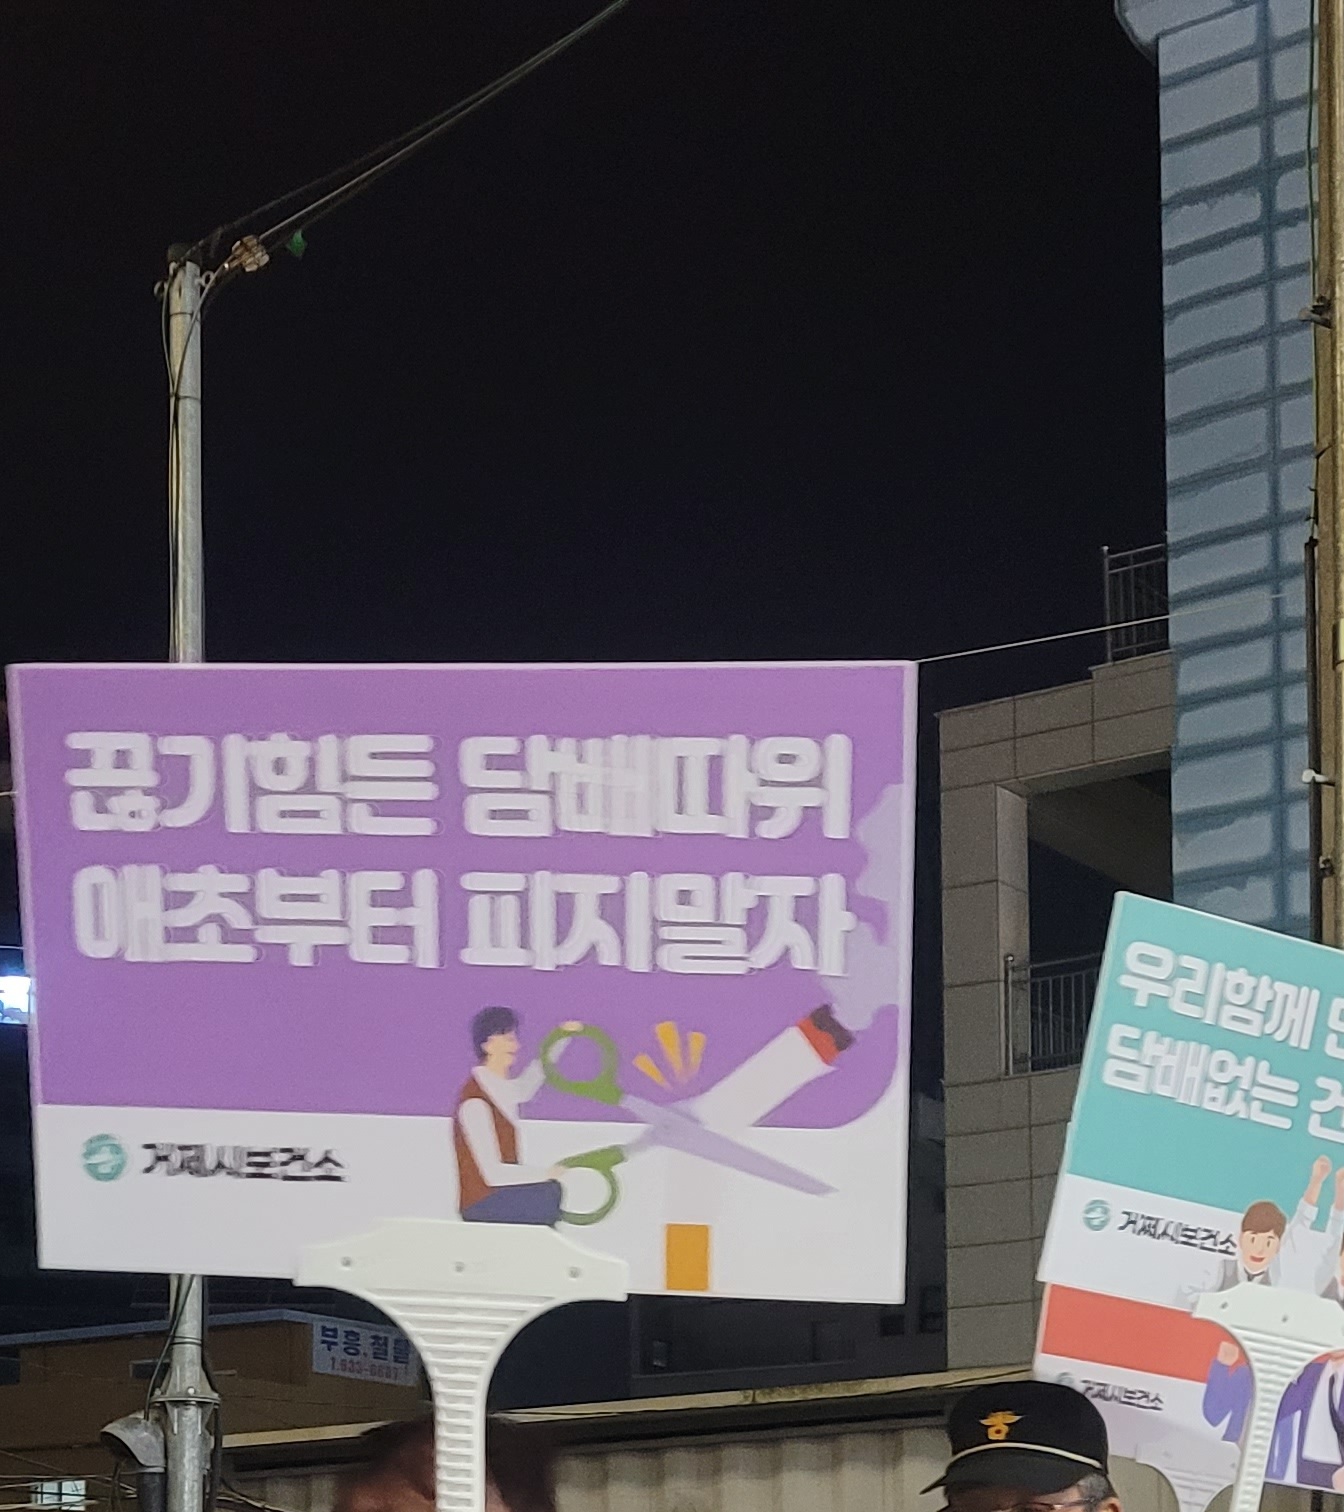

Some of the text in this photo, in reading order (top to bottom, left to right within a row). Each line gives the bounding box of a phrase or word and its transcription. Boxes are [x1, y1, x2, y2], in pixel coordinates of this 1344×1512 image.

[65, 731, 852, 838] 끊기힘든 담배따위
[72, 863, 855, 976] 애초부터 피지말자
[1119, 940, 1320, 1050] 우리함께
[1102, 1023, 1300, 1130] 담배없는
[141, 1142, 347, 1183] 거제시보건소
